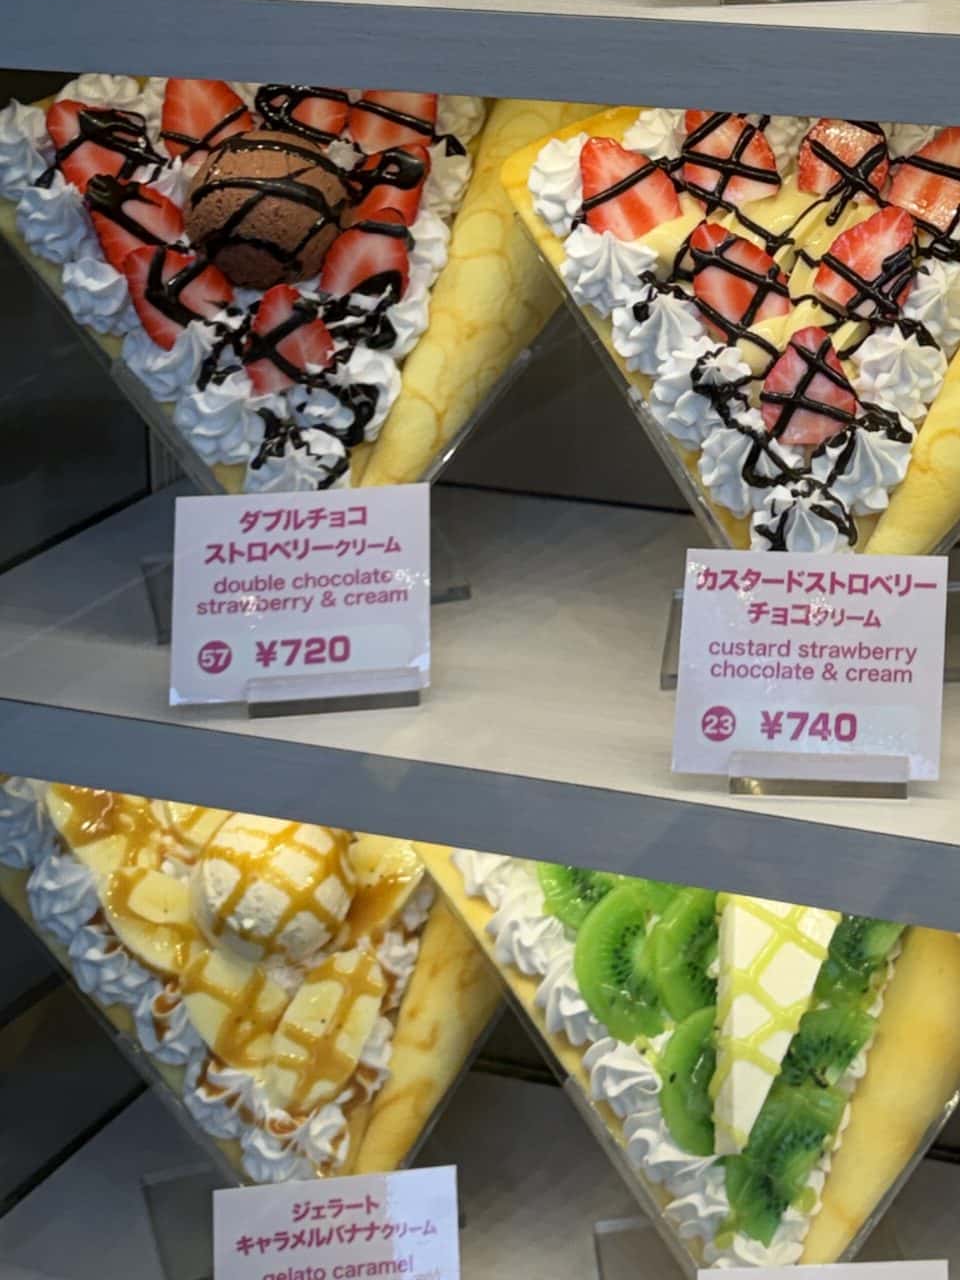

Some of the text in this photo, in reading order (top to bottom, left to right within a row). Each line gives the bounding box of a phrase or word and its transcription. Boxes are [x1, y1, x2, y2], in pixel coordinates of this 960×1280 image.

[239, 506, 367, 533] ダブルチョコ
[204, 537, 402, 565] ストロベリークリーム
[214, 570, 393, 594] double chocolate
[696, 569, 937, 596] カスタードストロベリー
[321, 591, 336, 608] &
[343, 589, 408, 606] cream
[748, 601, 881, 628] チョコクリーム
[201, 636, 350, 667] 57 ¥720
[708, 640, 917, 664] custard strawberry
[710, 661, 913, 682] chocolate & cream
[704, 711, 857, 742] 23 ¥740
[292, 1194, 379, 1222] ジェラート
[236, 1220, 437, 1256] キャラメルバナナクリーム
[332, 1255, 414, 1279] caramel
